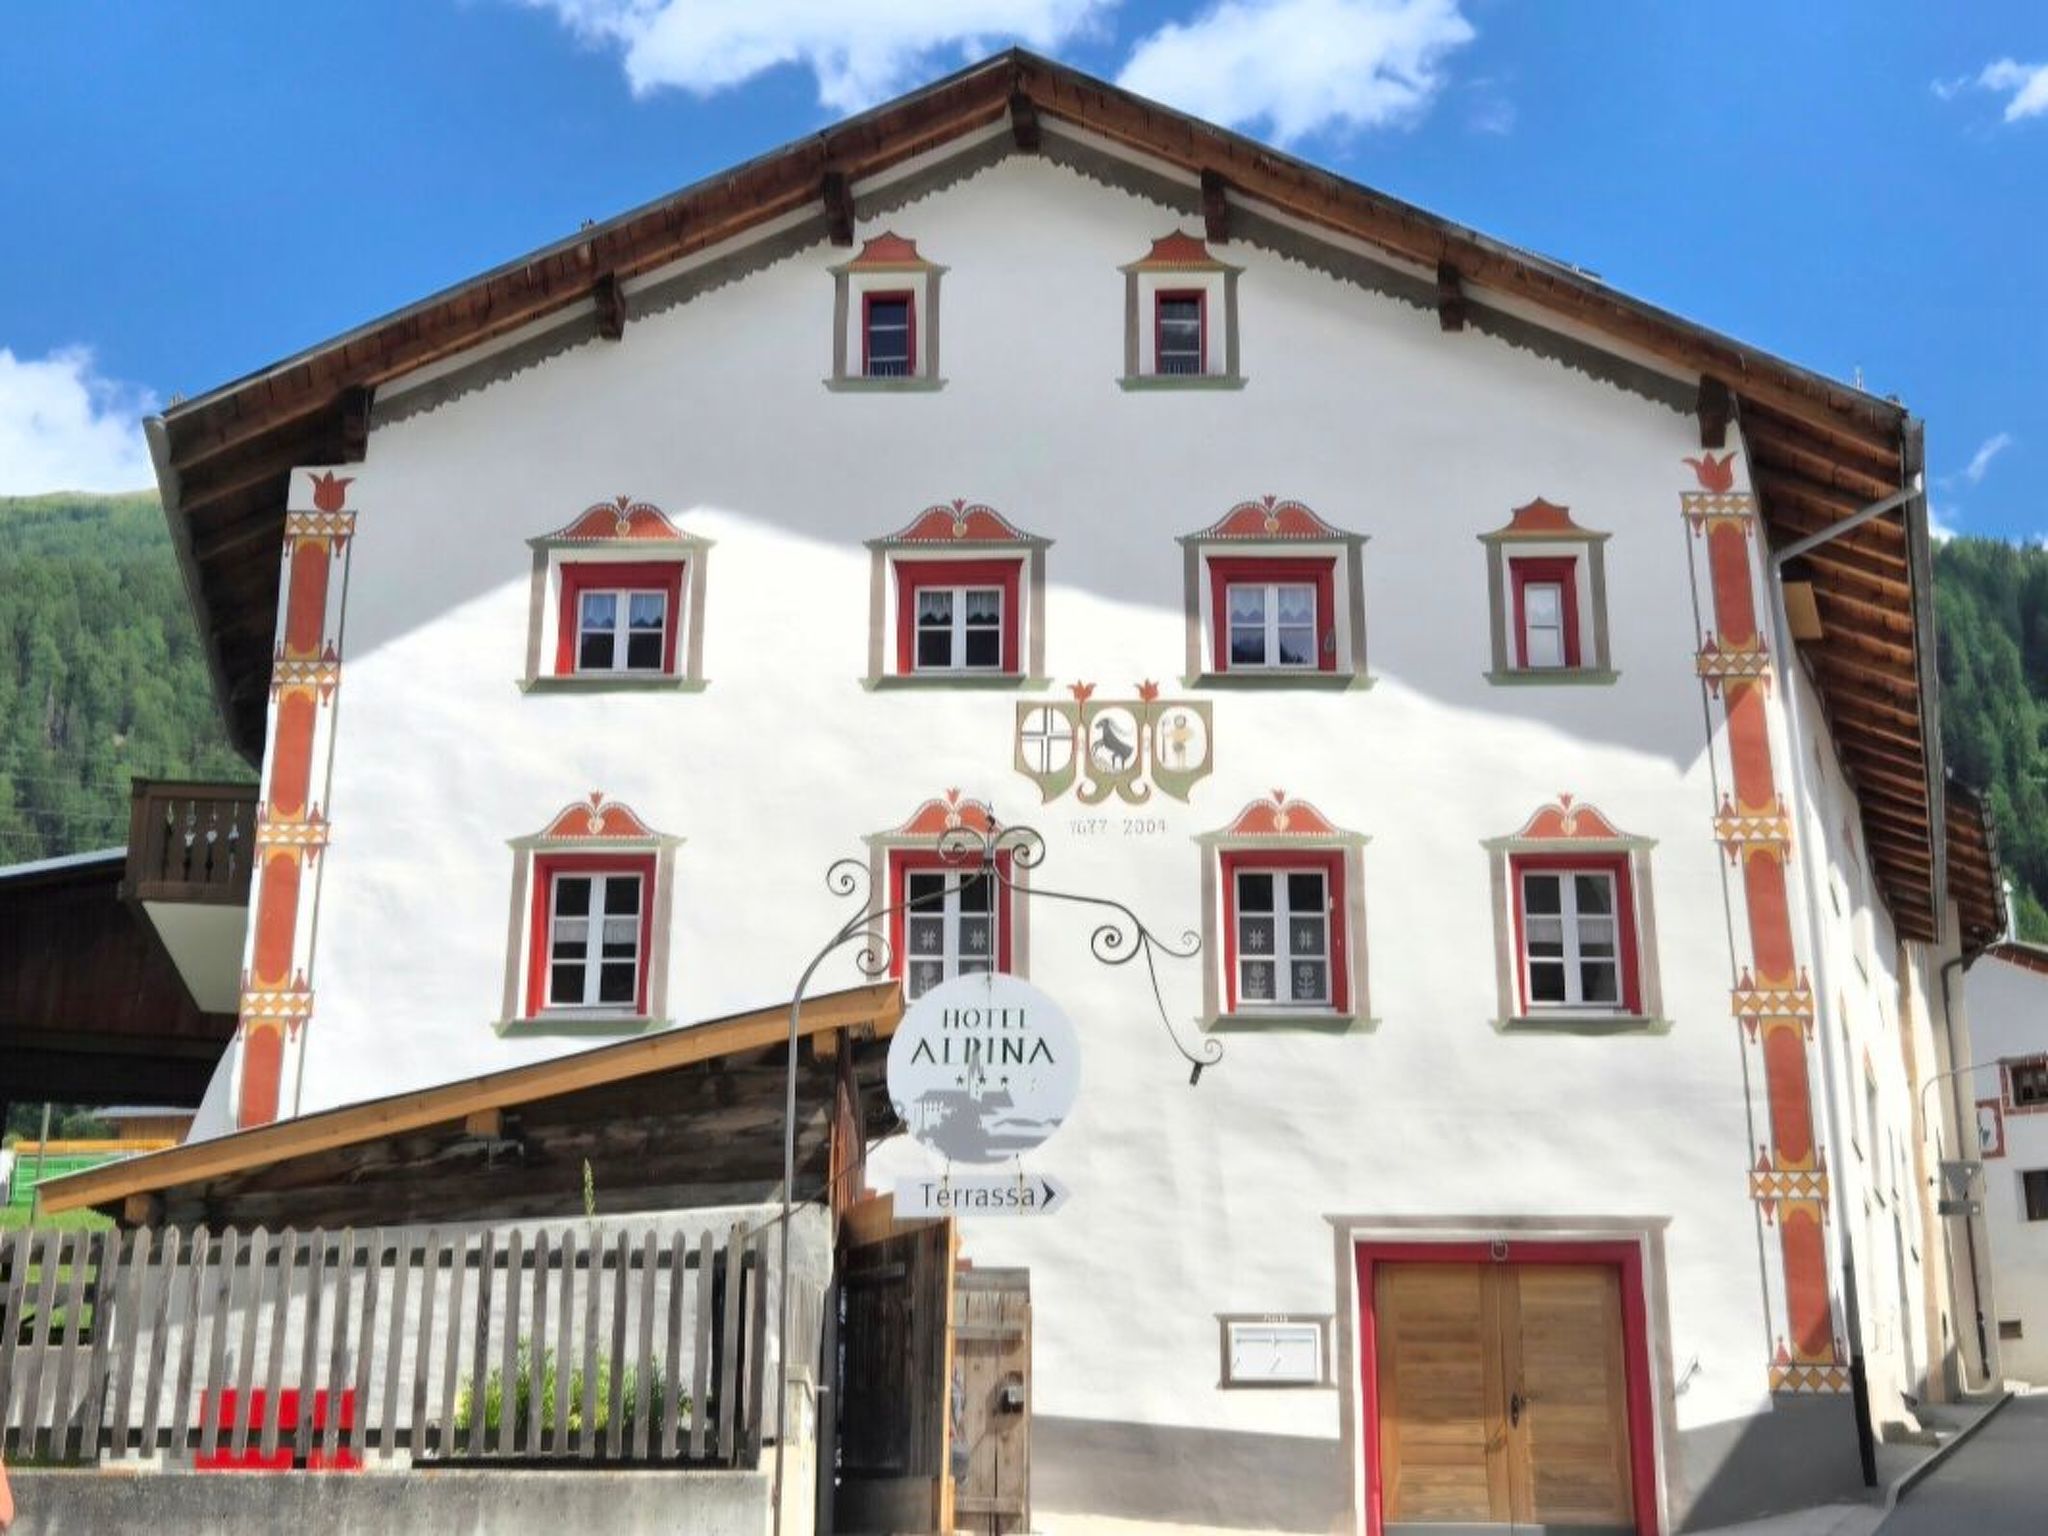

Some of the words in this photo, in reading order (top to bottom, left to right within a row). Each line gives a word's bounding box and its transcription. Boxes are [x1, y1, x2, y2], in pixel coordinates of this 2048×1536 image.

[943, 1008, 1031, 1029] HOTEL
[911, 1037, 1055, 1064] ALPINA
[920, 1182, 1035, 1208] Terrassa
